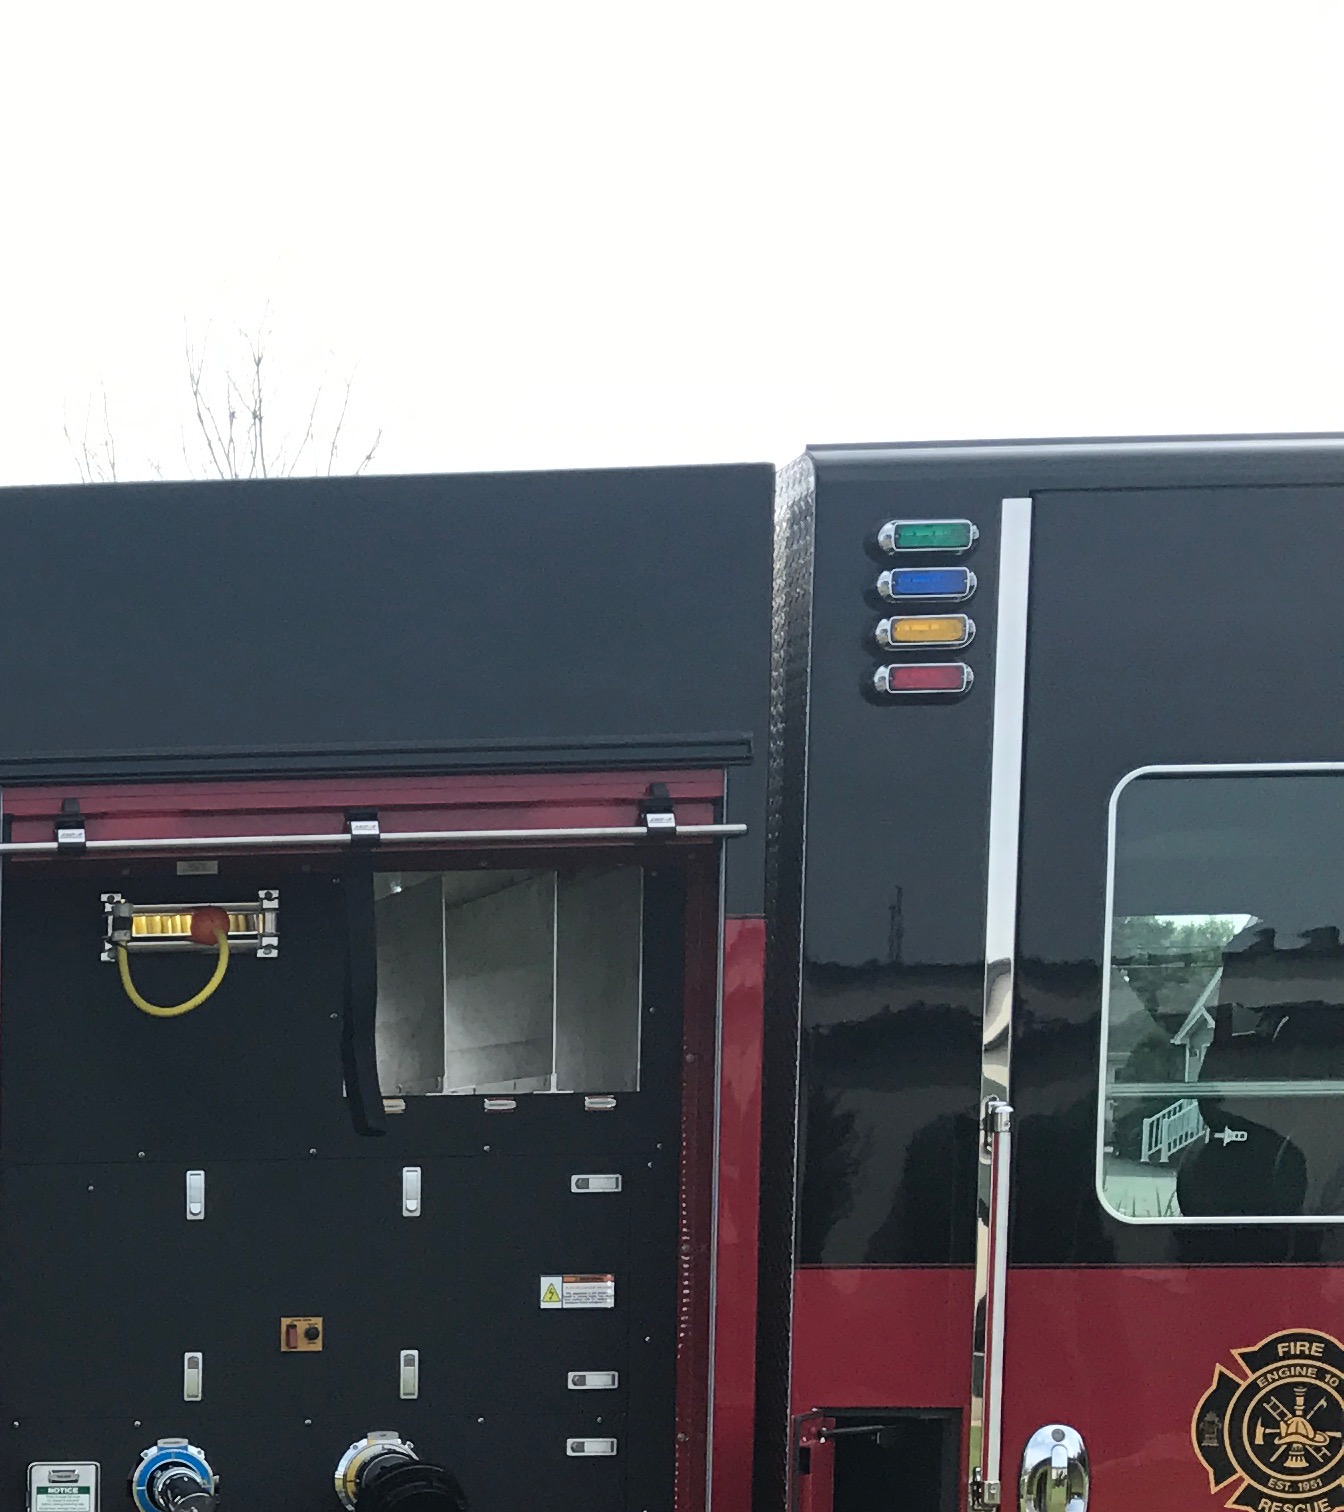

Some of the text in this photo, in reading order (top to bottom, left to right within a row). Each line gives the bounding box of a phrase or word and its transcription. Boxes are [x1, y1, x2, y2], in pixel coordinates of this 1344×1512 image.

[1276, 1341, 1325, 1357] FIRE
[1256, 1366, 1340, 1388] ENGINE 10
[1267, 1477, 1323, 1492] EST. 1951
